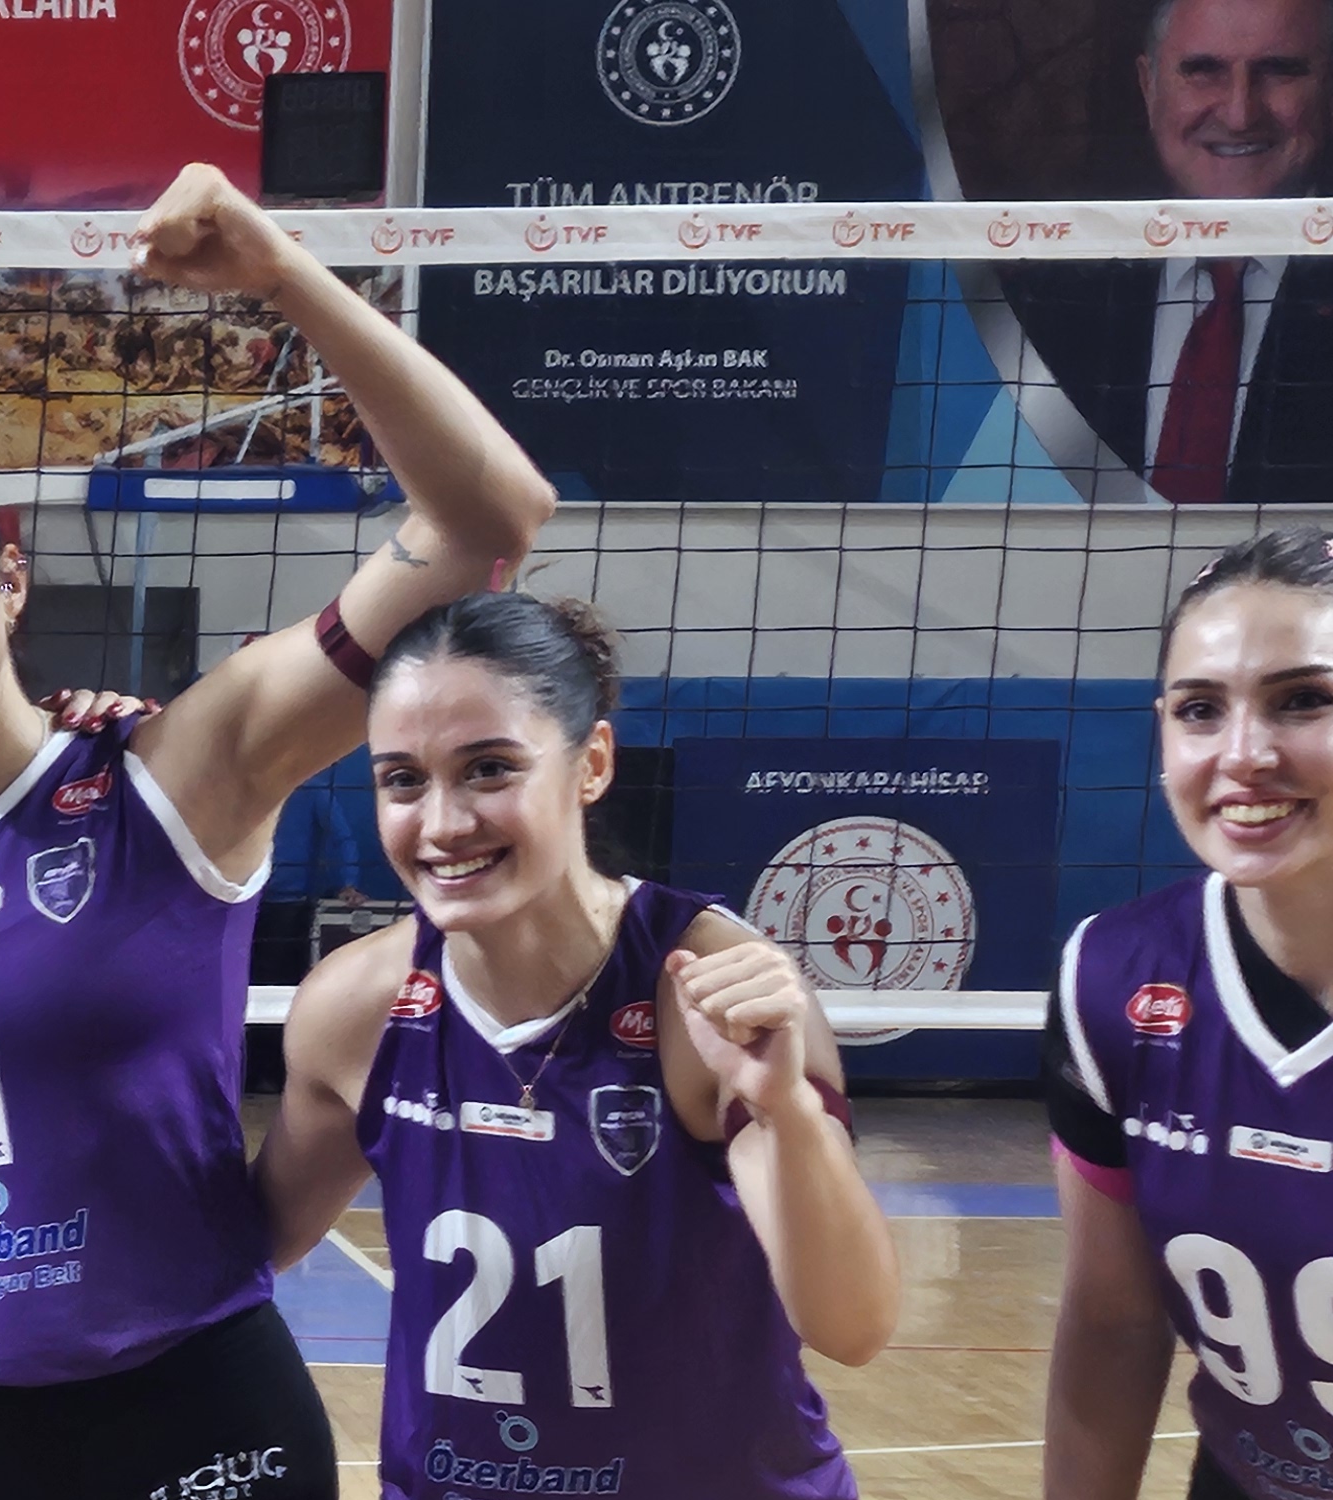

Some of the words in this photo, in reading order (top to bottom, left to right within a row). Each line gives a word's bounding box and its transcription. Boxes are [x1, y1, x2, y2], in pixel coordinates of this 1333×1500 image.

[410, 228, 455, 246] TVF
[563, 225, 608, 243] TVF
[716, 223, 763, 241] TVF
[869, 222, 915, 241] TVF
[1025, 222, 1071, 240] TVF
[1183, 220, 1229, 240] TVF
[473, 269, 654, 302] BAŞARILAR
[662, 263, 847, 295] DİLİYORUM
[722, 348, 769, 368] BAK
[422, 1209, 615, 1409] 21
[424, 1438, 625, 1494] Özerband
